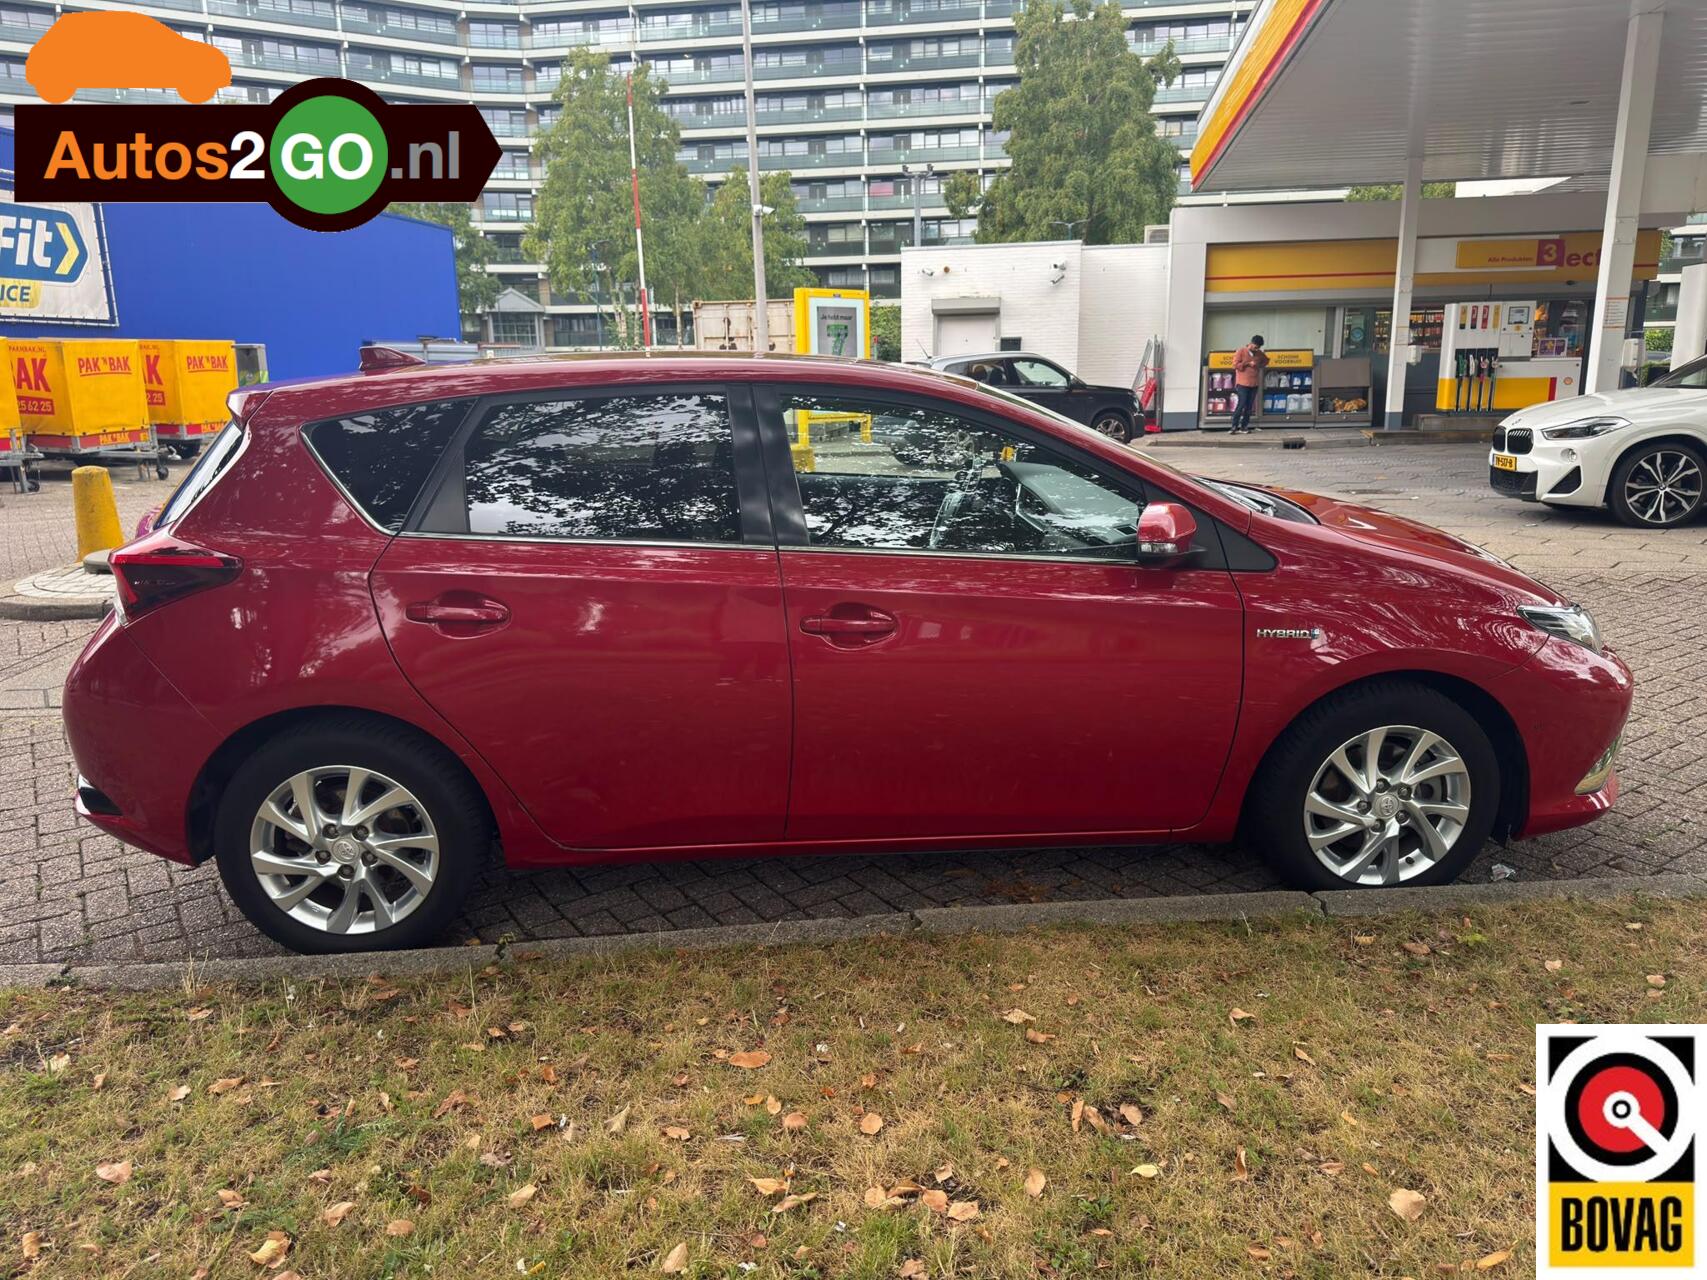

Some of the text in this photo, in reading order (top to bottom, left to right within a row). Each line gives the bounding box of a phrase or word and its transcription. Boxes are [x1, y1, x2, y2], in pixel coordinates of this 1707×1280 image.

[78, 357, 100, 373] PAK
[108, 356, 131, 371] BAK
[187, 356, 204, 370] PAK
[211, 355, 228, 369] BAK
[28, 401, 38, 412] 62
[40, 401, 52, 412] 25
[1256, 628, 1311, 639] HYBRID
